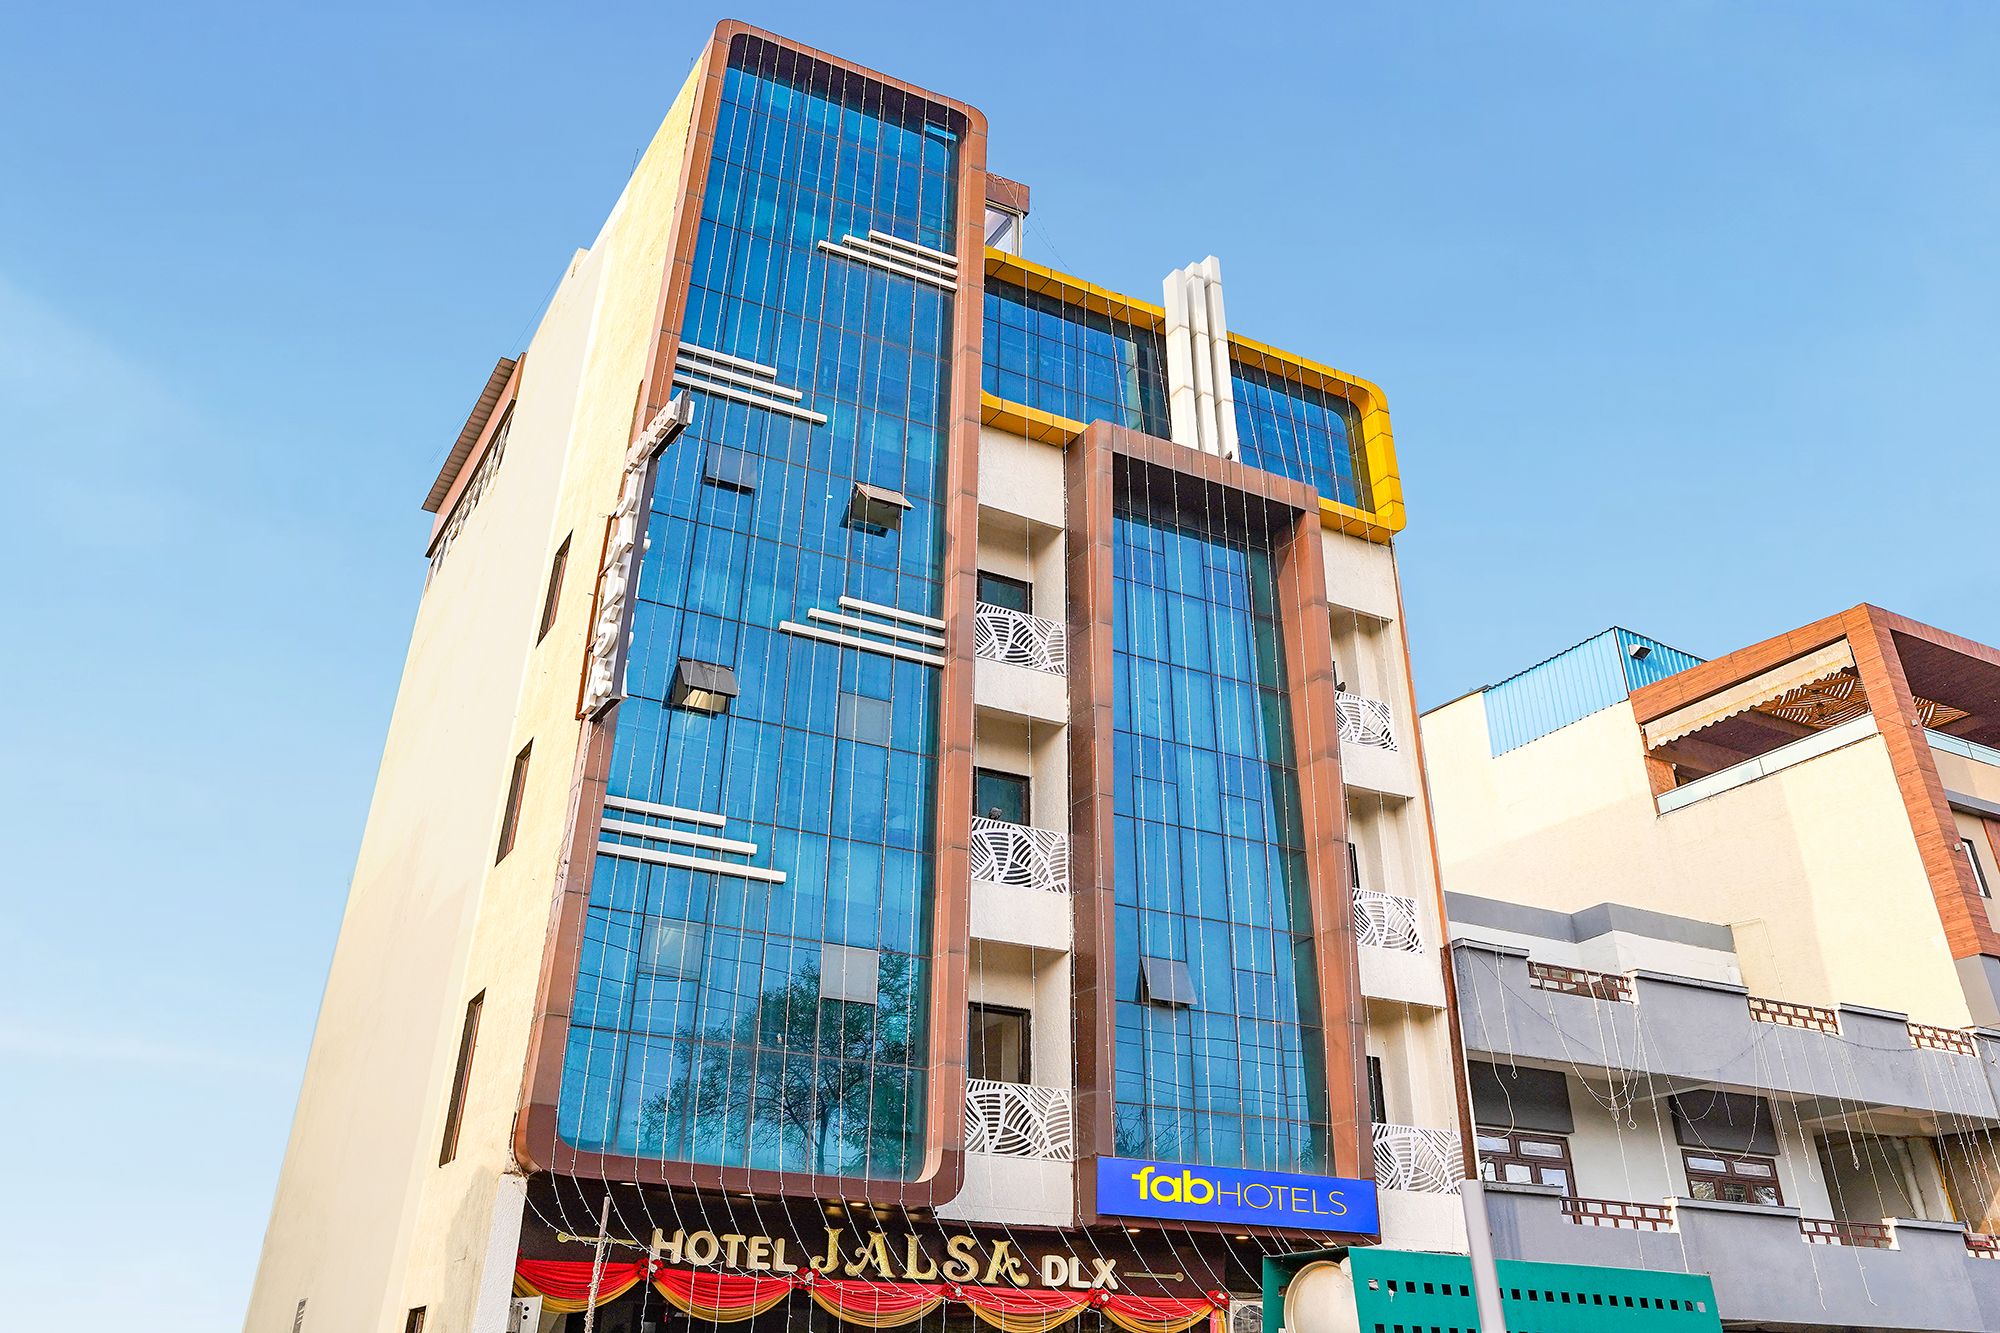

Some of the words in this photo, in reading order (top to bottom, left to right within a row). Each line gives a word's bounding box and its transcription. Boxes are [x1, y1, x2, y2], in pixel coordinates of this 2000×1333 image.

[650, 1228, 798, 1273] HOTEL
[810, 1226, 1030, 1287] JALSA
[1041, 1254, 1119, 1290] DLX
